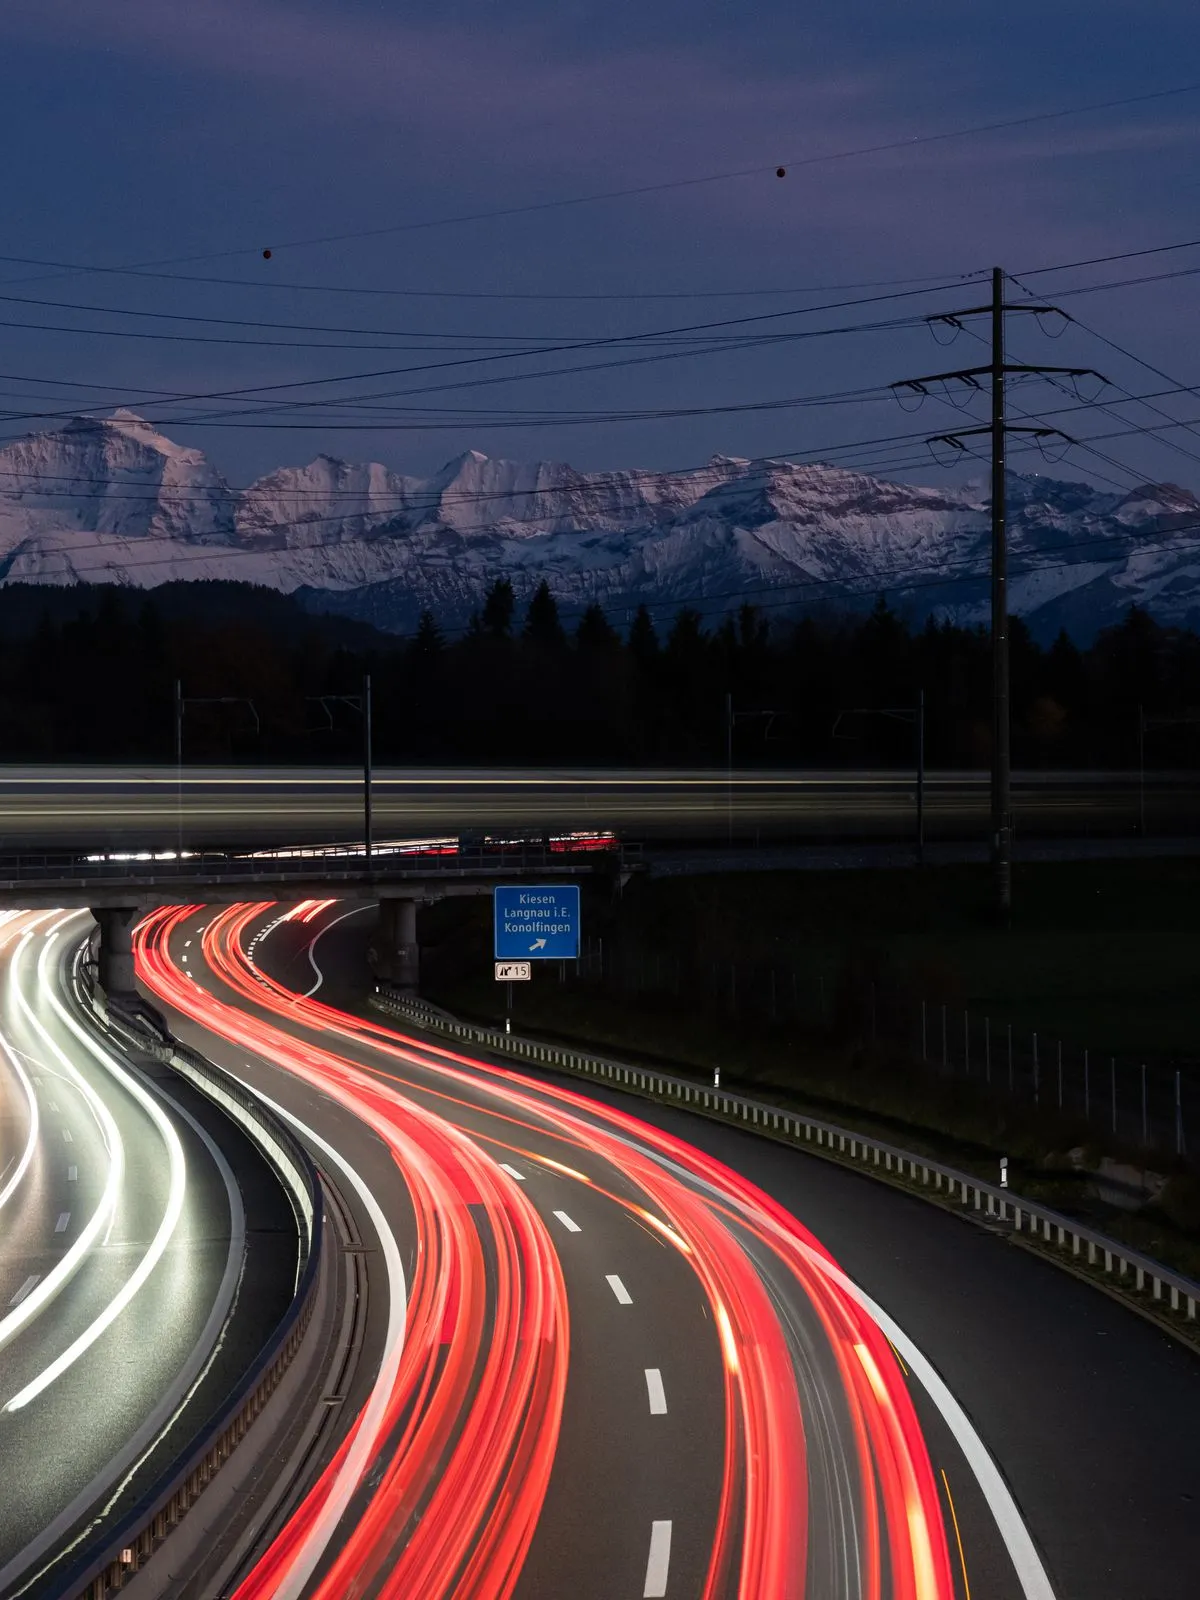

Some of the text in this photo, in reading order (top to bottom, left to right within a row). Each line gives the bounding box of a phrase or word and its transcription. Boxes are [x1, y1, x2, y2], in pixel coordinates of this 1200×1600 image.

[519, 894, 555, 904] Kiesen
[504, 907, 571, 920] Langnau i.E.
[504, 922, 571, 934] Konolfingen
[514, 966, 527, 976] 15
